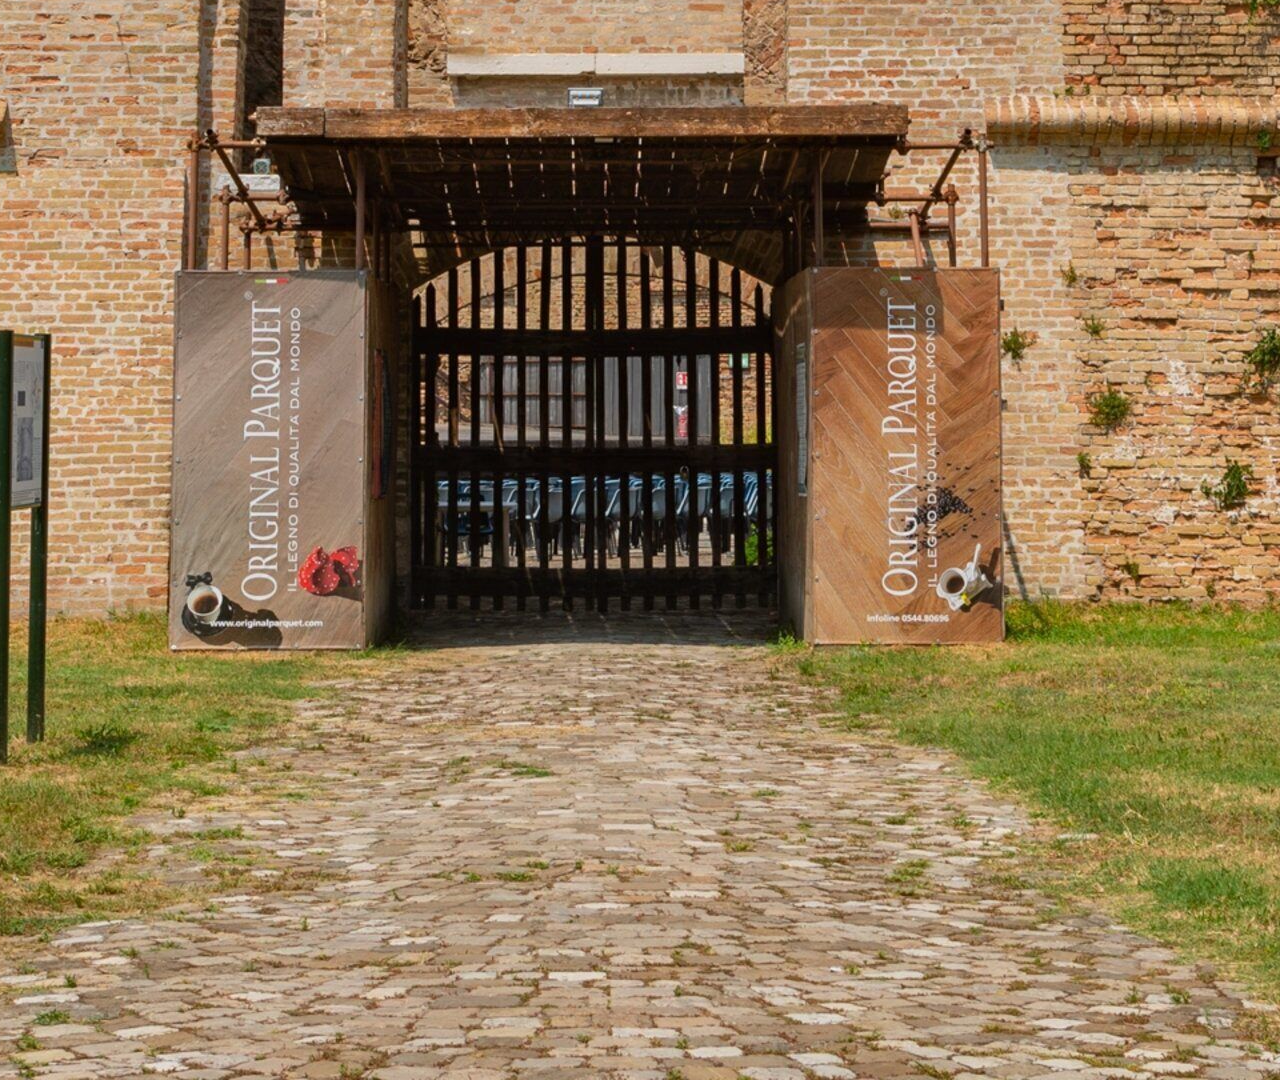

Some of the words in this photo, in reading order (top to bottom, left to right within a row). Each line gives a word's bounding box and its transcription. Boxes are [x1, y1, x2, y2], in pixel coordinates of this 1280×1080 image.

[290, 307, 301, 372] MONDO
[925, 305, 936, 368] MONDO
[244, 301, 281, 441] PARQUET
[881, 297, 917, 435] PARQUET
[289, 376, 300, 409] DAL
[926, 373, 936, 406] DAL
[288, 491, 298, 509] DI
[928, 487, 937, 505] DI
[241, 447, 280, 602] ORIGINAL
[881, 443, 918, 598] ORIGINAL
[927, 510, 937, 568] LEGNO
[288, 514, 298, 574] LEGNO
[288, 578, 298, 592] IL
[928, 573, 938, 588] IL
[210, 619, 323, 628] www.originalparquet.com
[867, 614, 900, 622] Infoline
